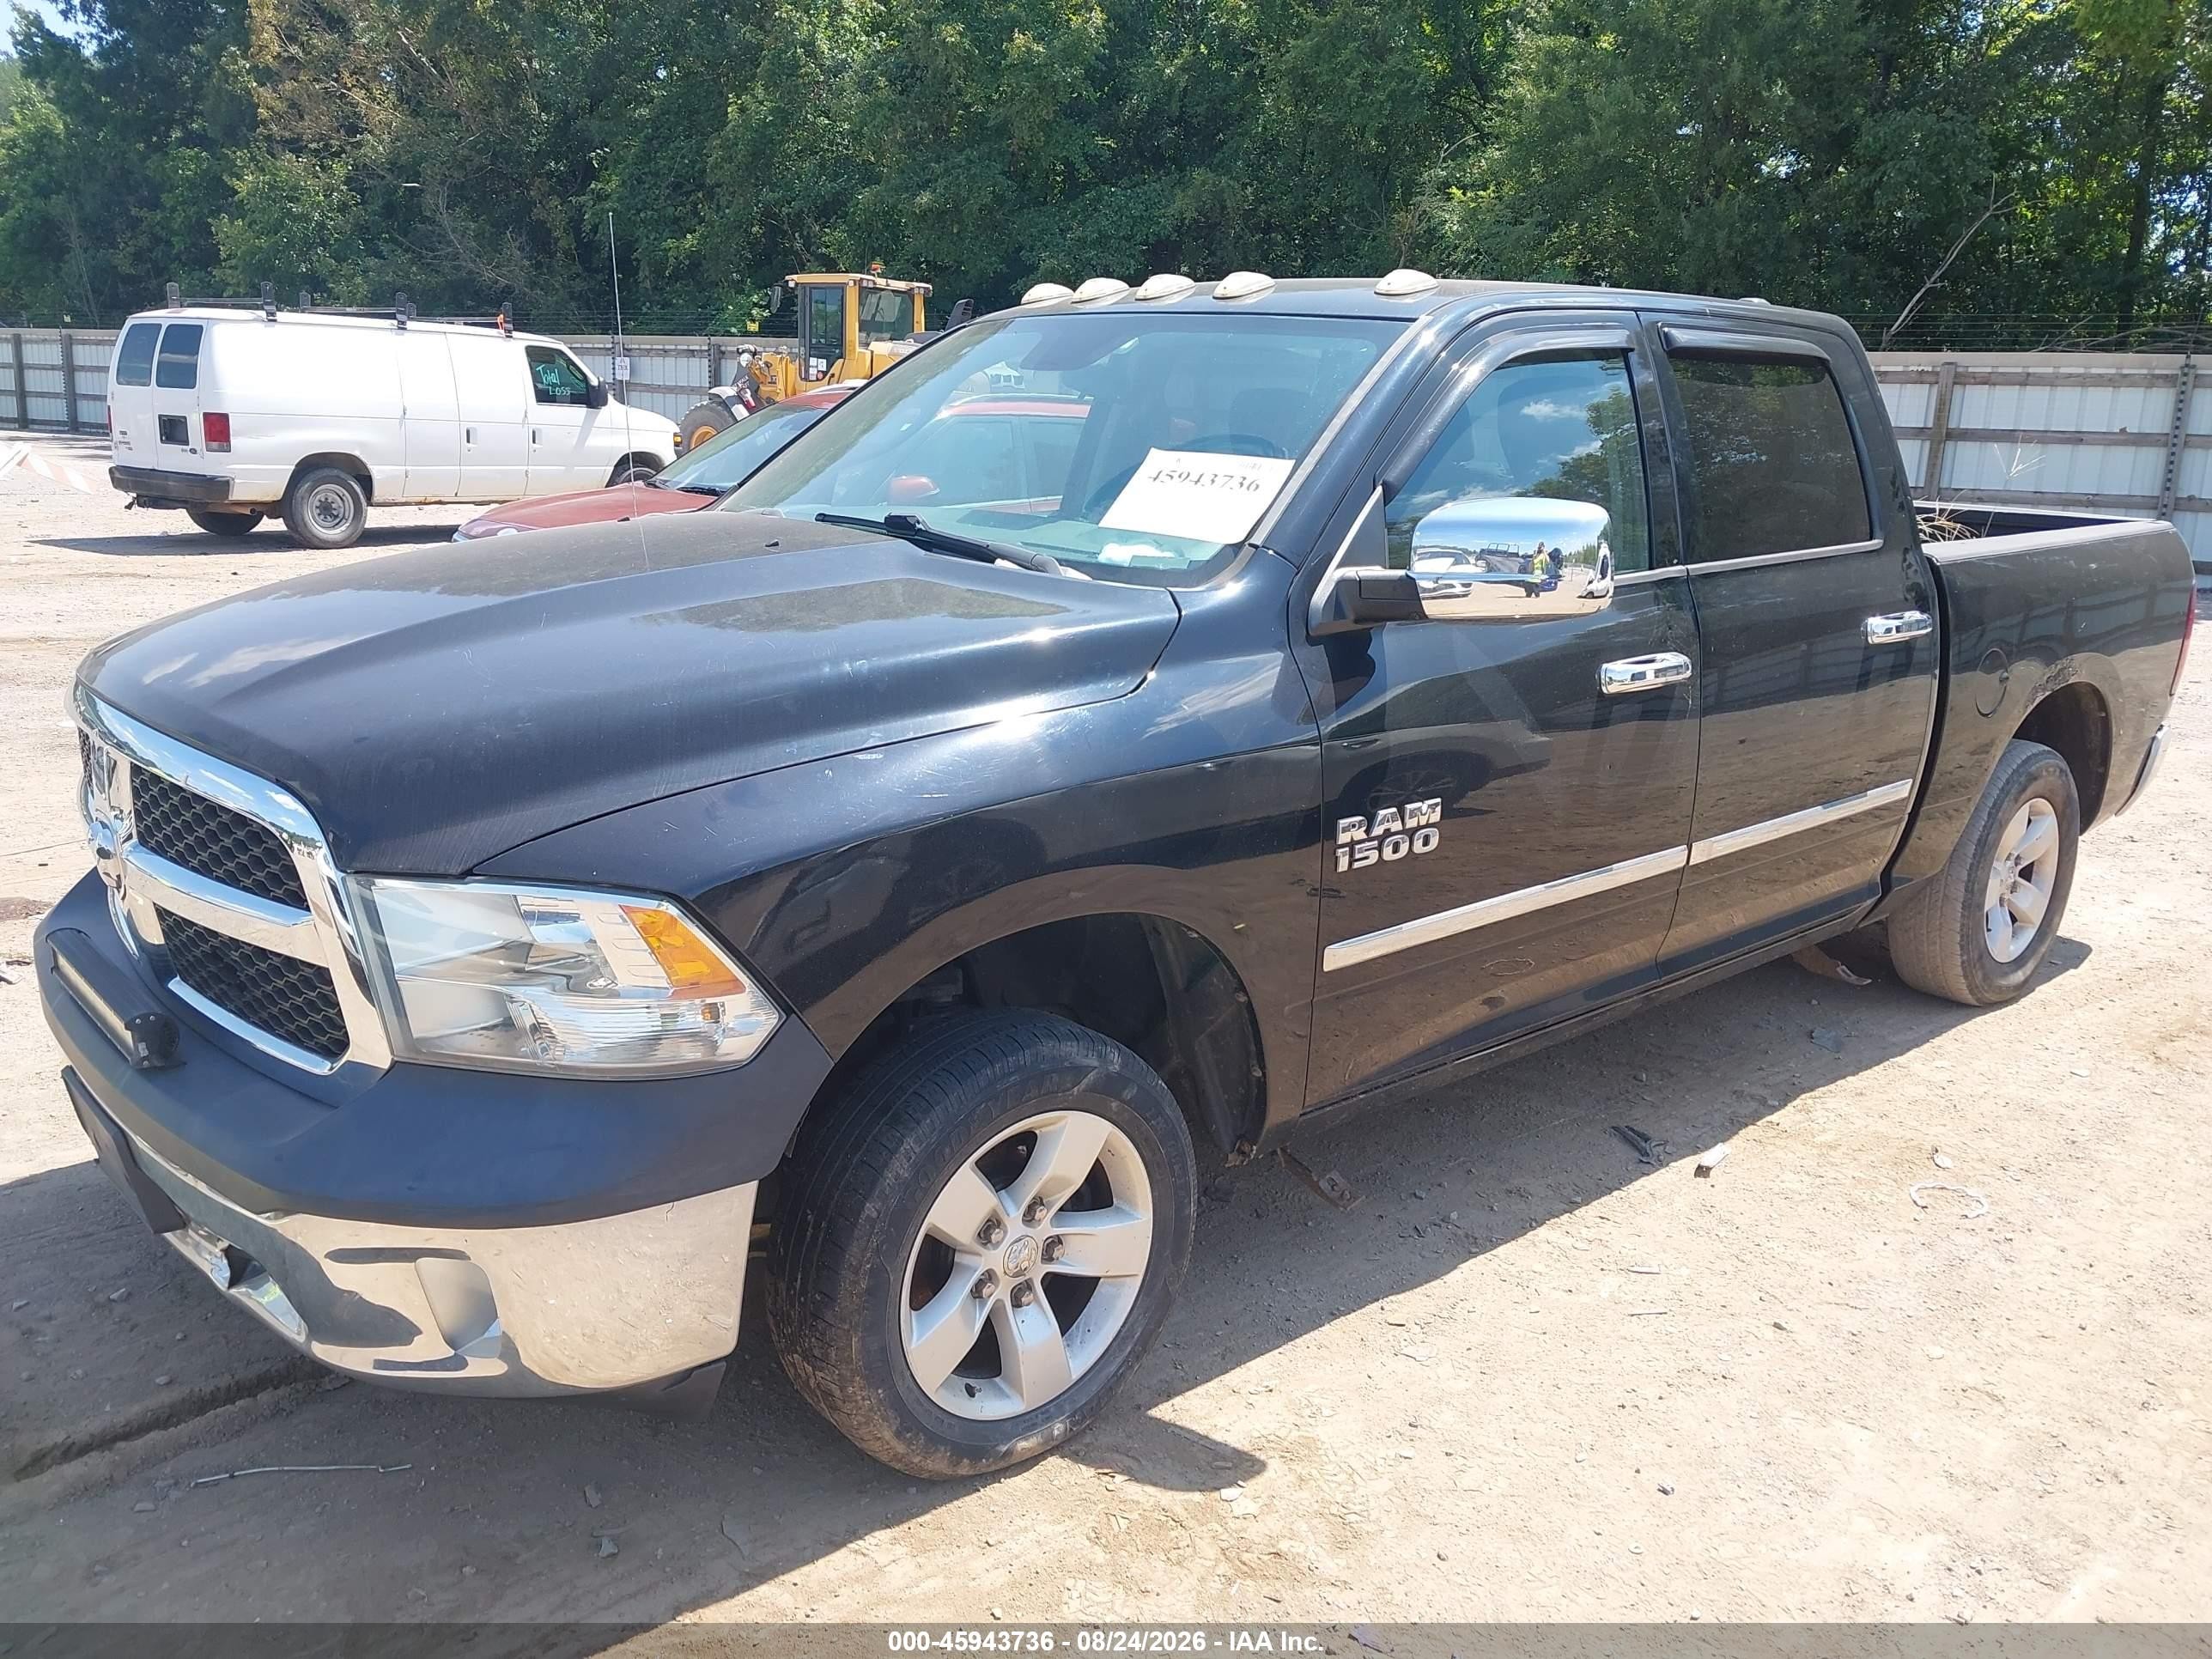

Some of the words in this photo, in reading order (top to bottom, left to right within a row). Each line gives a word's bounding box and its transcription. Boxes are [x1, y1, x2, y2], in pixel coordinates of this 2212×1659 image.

[536, 364, 560, 385] Total
[1148, 470, 1260, 492] 45943736
[1336, 798, 1443, 845] RAM
[1334, 827, 1440, 873] 1500
